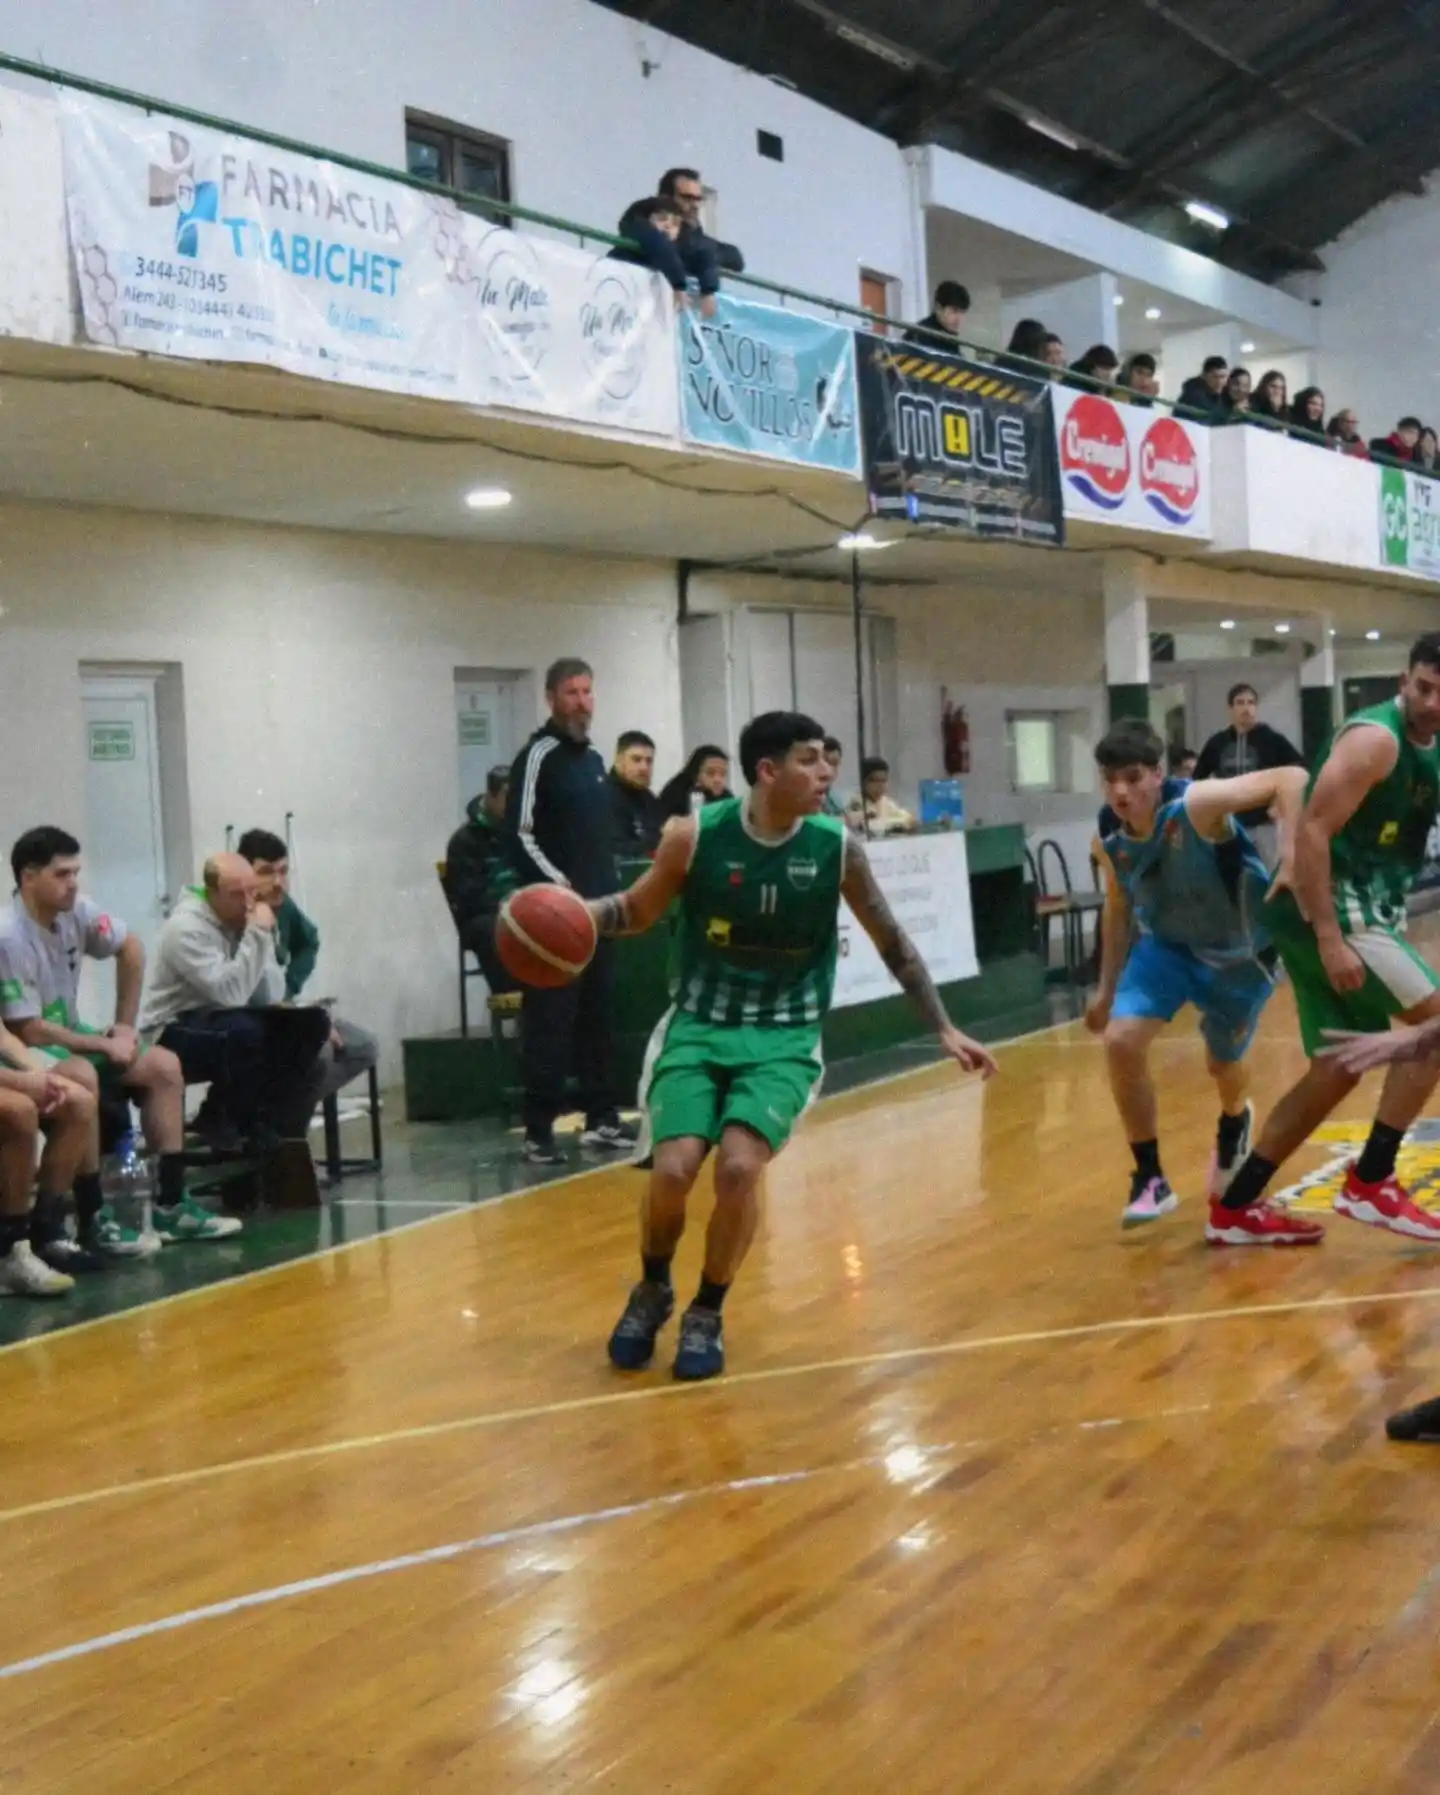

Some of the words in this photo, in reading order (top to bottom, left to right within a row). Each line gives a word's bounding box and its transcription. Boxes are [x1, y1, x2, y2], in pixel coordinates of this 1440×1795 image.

[221, 154, 404, 241] FARMACIA
[221, 217, 402, 297] TABICHET
[760, 884, 777, 915] 11
